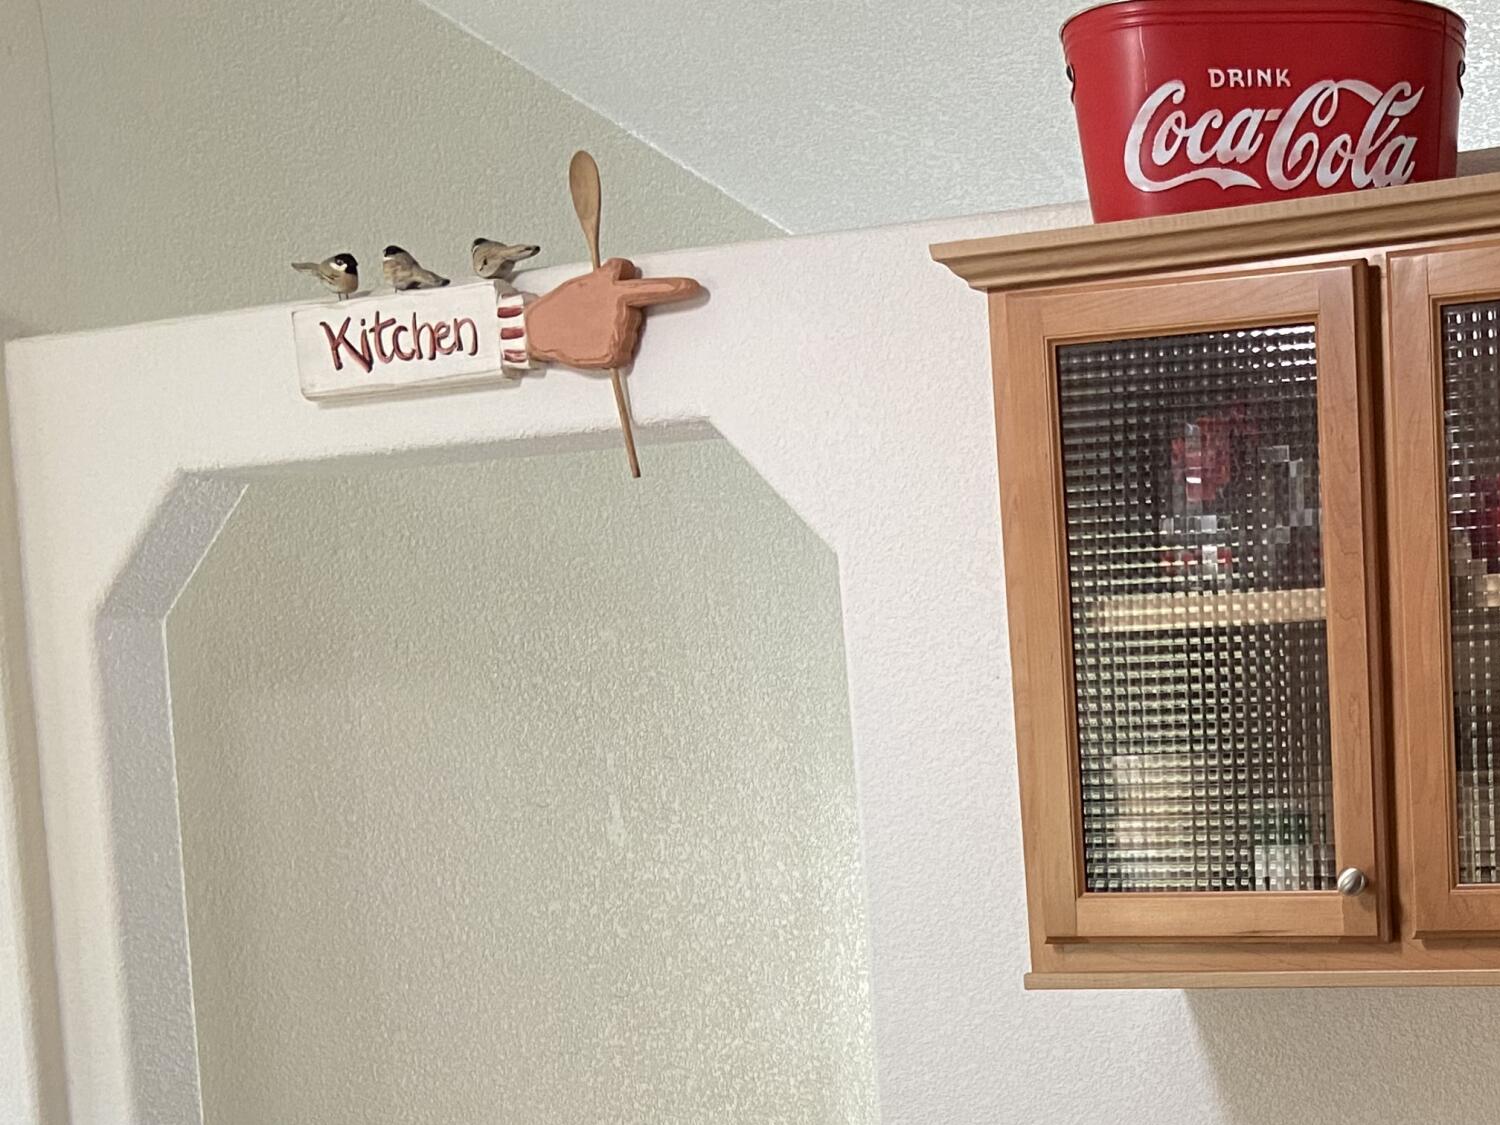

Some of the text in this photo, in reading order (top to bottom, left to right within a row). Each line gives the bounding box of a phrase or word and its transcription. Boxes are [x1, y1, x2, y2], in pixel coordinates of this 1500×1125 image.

[1208, 68, 1292, 88] DRINK
[1124, 79, 1424, 192] Coca-Cola
[319, 310, 478, 374] Kitchen
